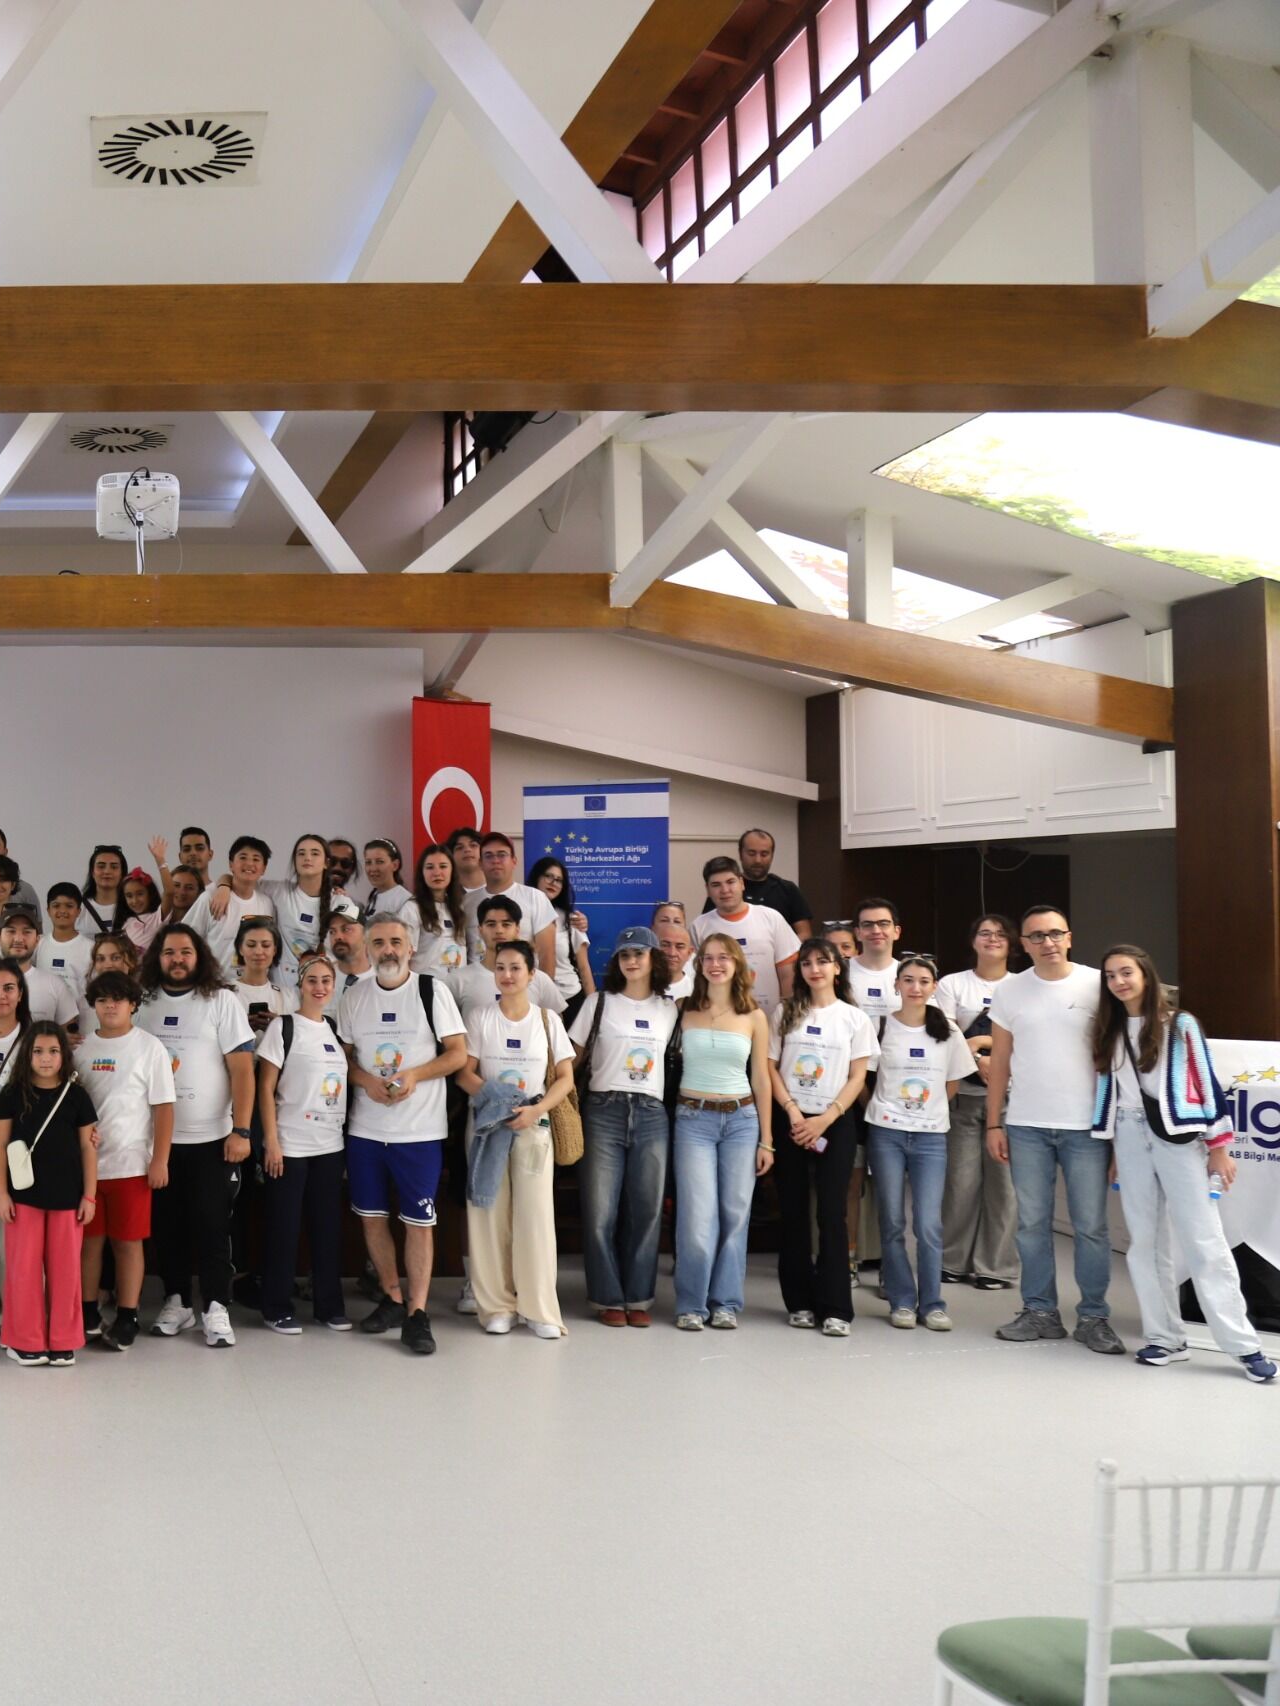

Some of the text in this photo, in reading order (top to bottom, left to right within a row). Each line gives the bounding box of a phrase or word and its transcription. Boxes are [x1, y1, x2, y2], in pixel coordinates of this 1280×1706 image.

[625, 845, 648, 854] Birliği
[565, 855, 582, 863] Bilgi
[627, 855, 640, 863] Ağı
[597, 869, 605, 877] of
[606, 869, 619, 877] the
[576, 877, 621, 885] Information
[622, 877, 652, 885] Centres
[1229, 1151, 1242, 1159] AB
[1244, 1151, 1265, 1162] Bilgi
